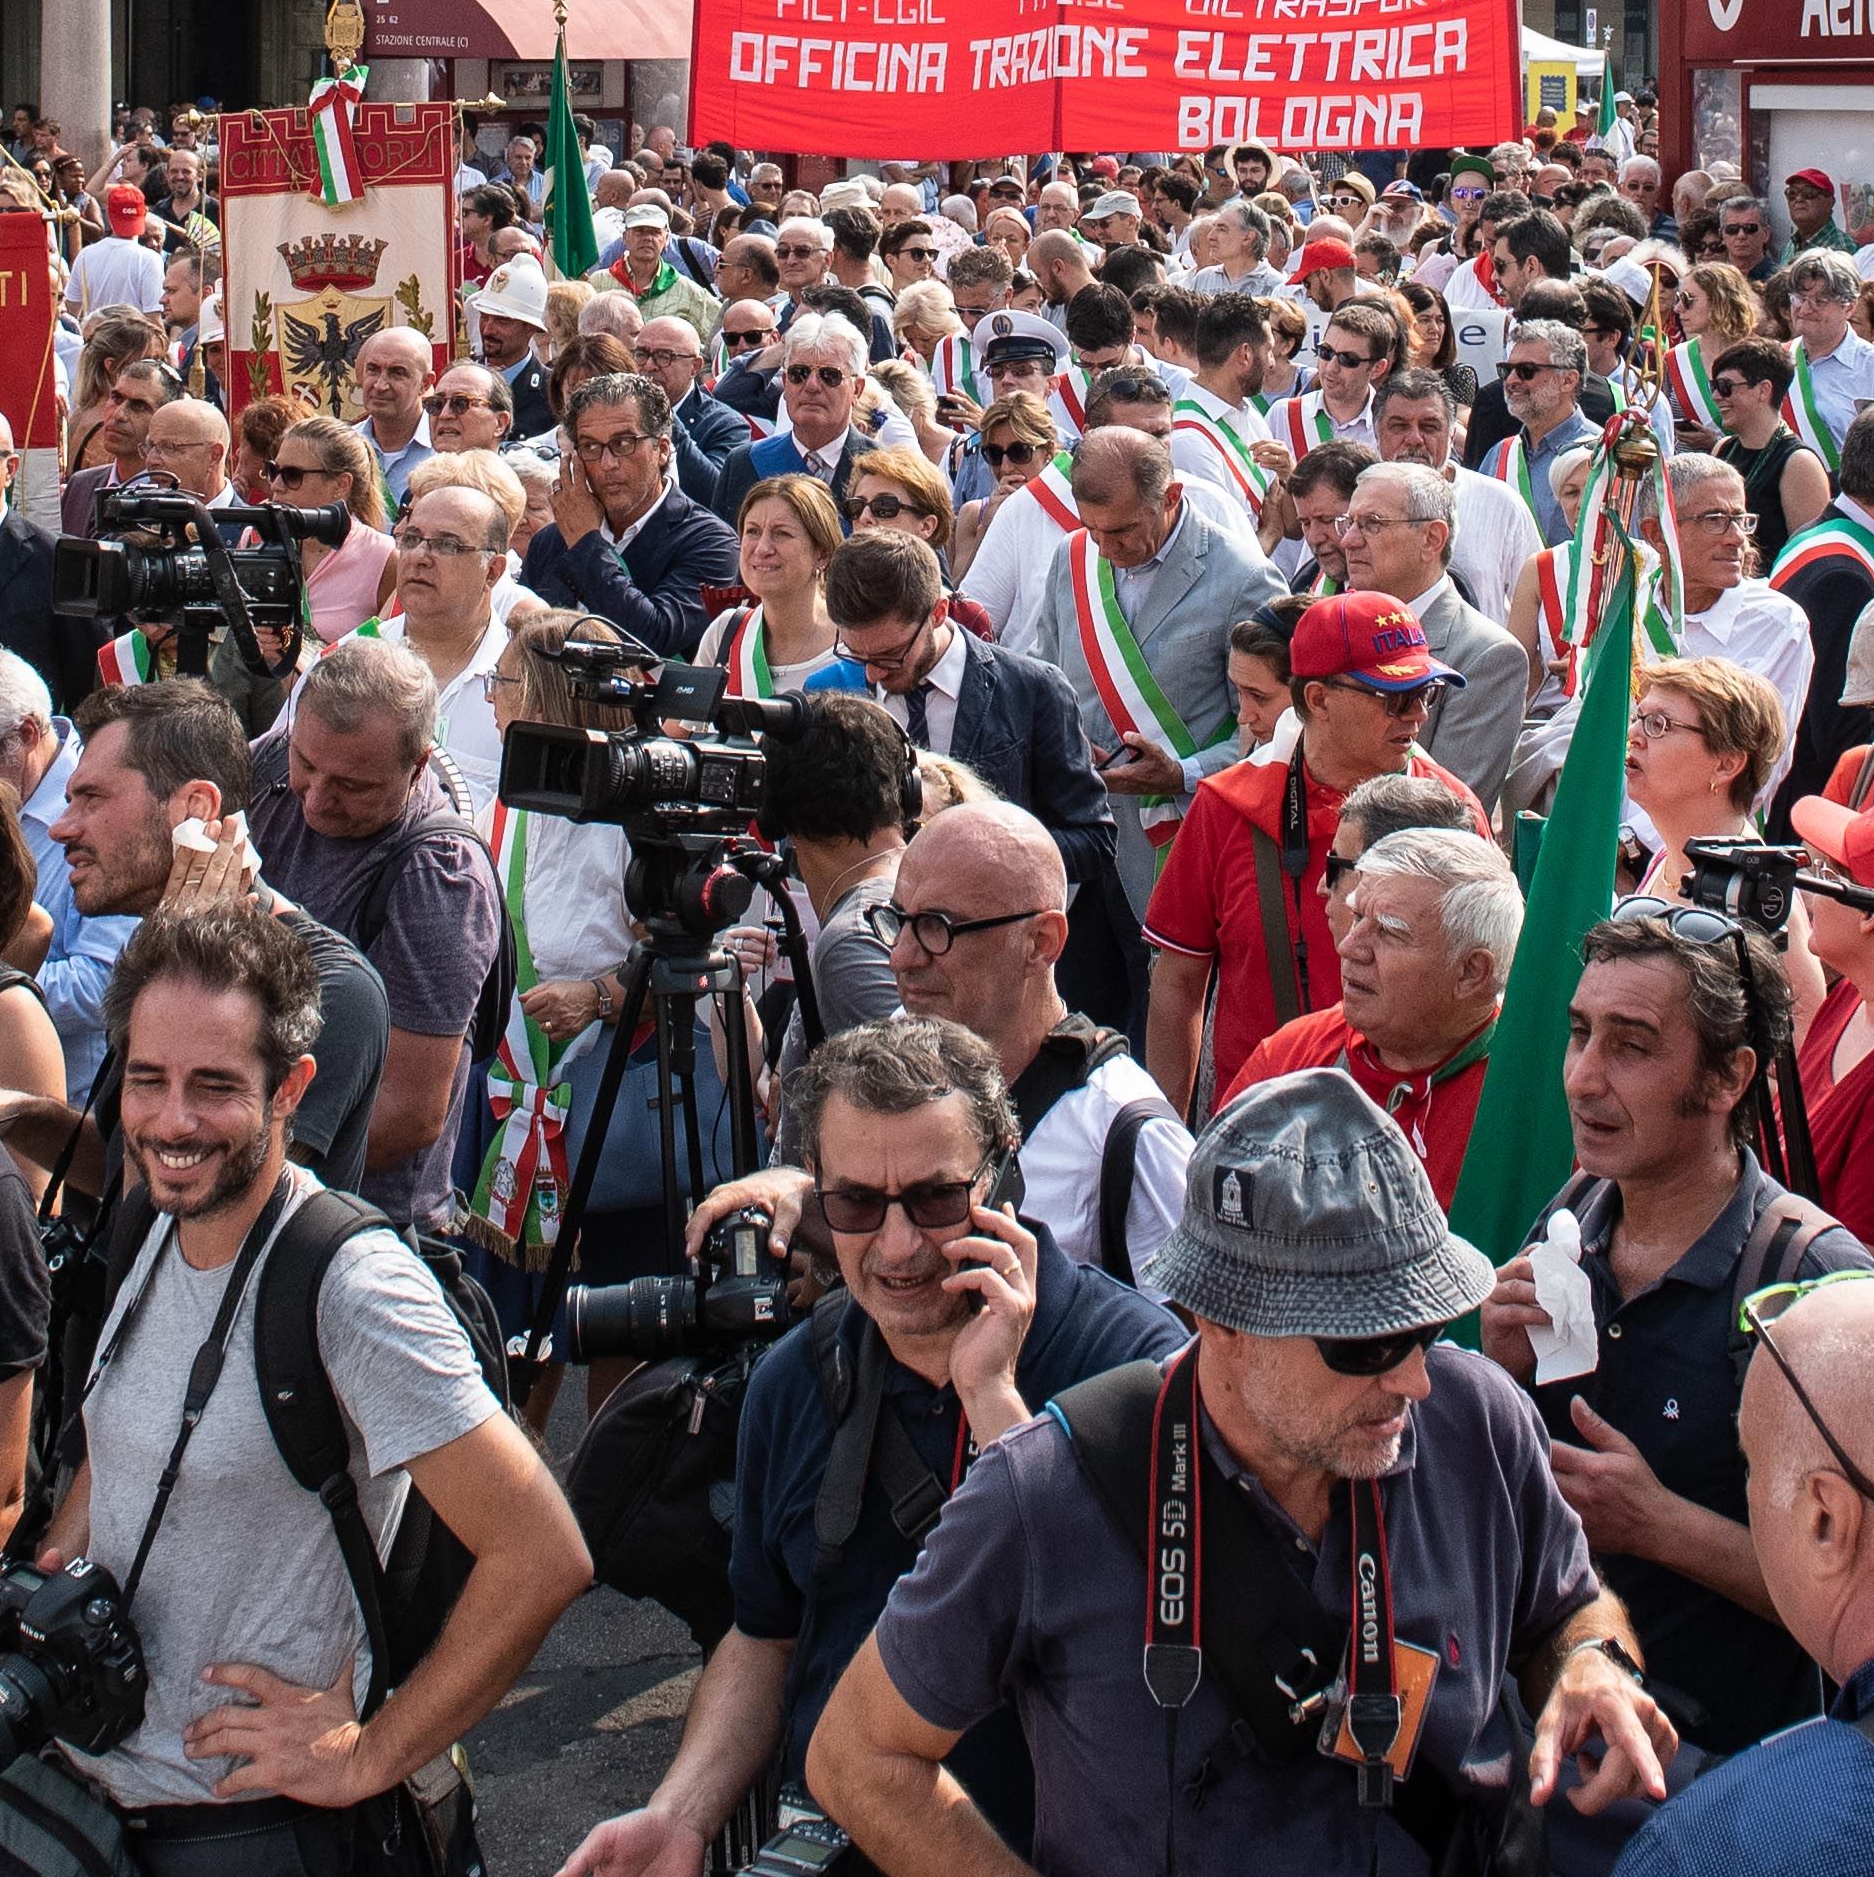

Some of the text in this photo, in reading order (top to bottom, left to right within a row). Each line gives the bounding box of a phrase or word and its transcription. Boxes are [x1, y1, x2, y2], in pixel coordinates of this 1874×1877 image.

[375, 33, 414, 47] STAZIONE
[415, 35, 456, 48] CENTRALE
[728, 17, 1468, 94] OFFICINA TRAZIONE ELETTRICA
[1177, 91, 1424, 150] BOLOGNA
[1288, 775, 1299, 831] DIGITAL
[1159, 1423, 1187, 1626] EOS 5D Mark III
[19, 1621, 46, 1643] Nikon
[1358, 1552, 1380, 1664] Canon
